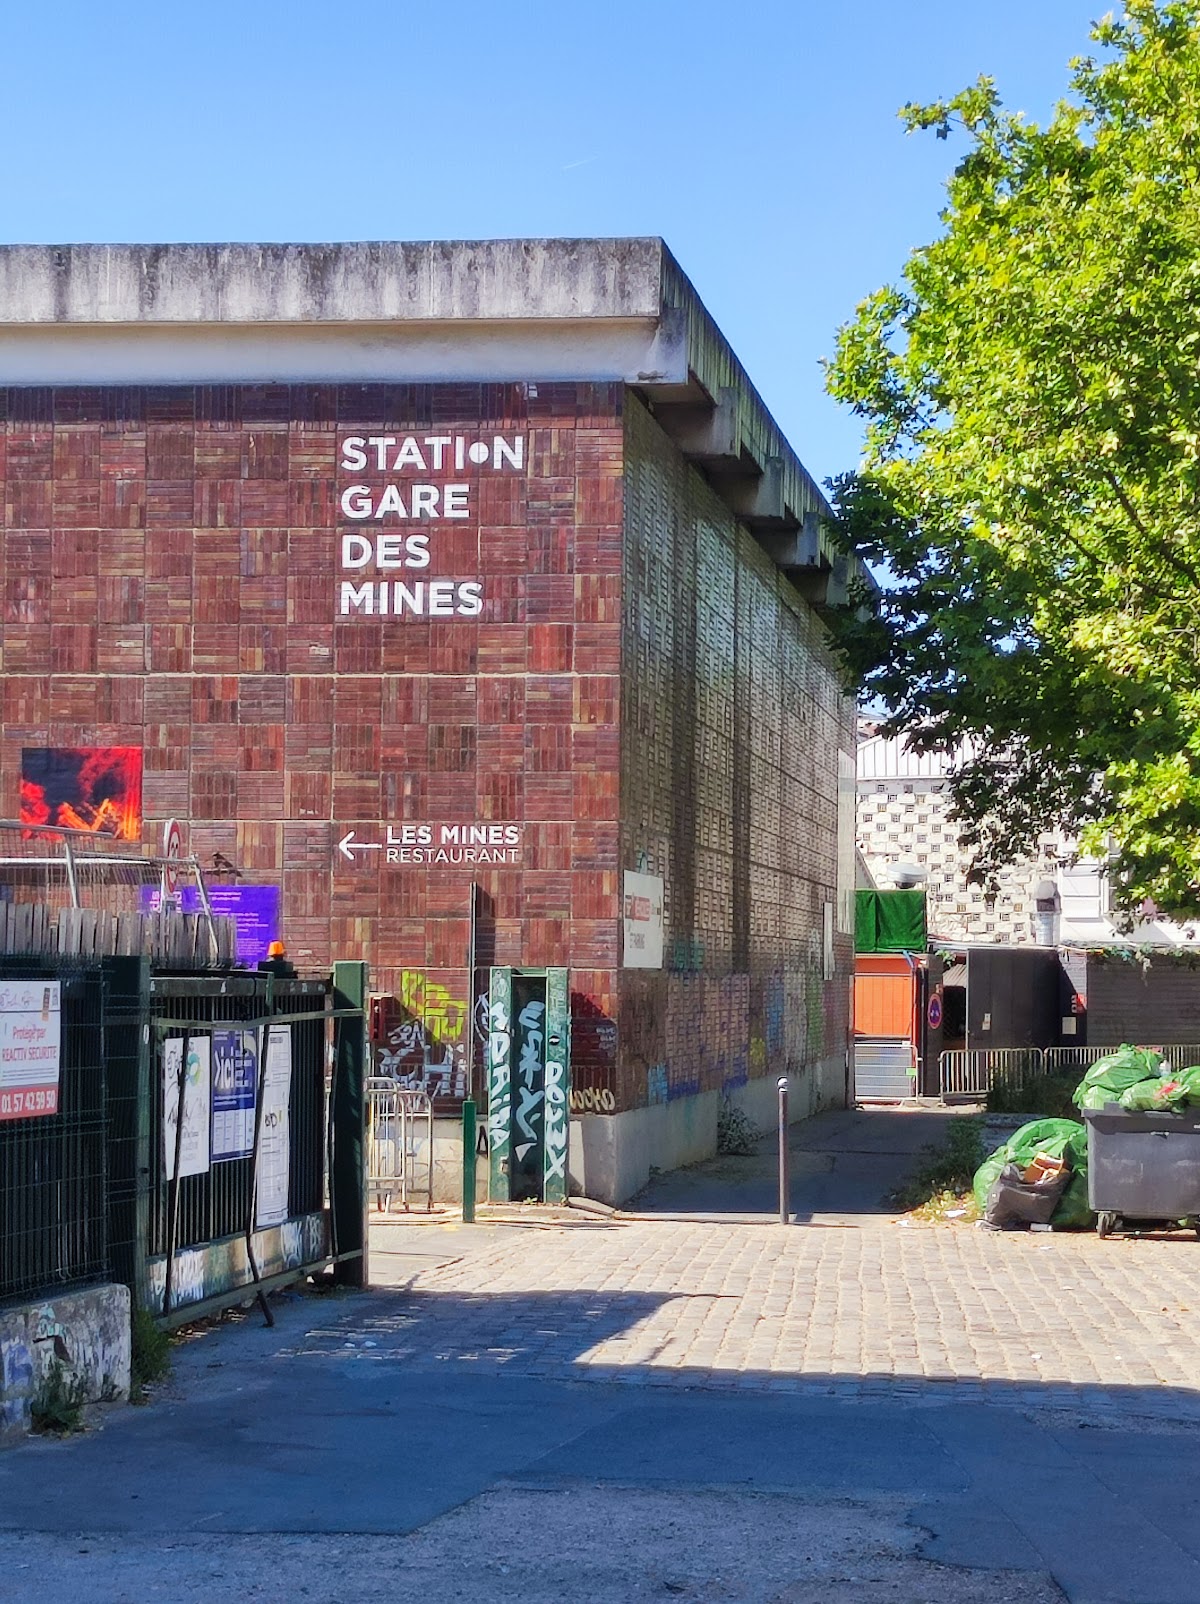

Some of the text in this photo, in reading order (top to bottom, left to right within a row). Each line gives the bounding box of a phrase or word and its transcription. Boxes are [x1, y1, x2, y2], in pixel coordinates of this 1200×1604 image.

[341, 436, 524, 471] STATION
[341, 484, 470, 519] GARE
[341, 534, 431, 569] DES
[340, 581, 483, 616] MINES
[386, 825, 520, 845] LES MINES
[386, 847, 519, 864] RESTAURANT
[1, 1094, 12, 1114] 01
[13, 1093, 24, 1112] 57
[25, 1091, 35, 1111] 42
